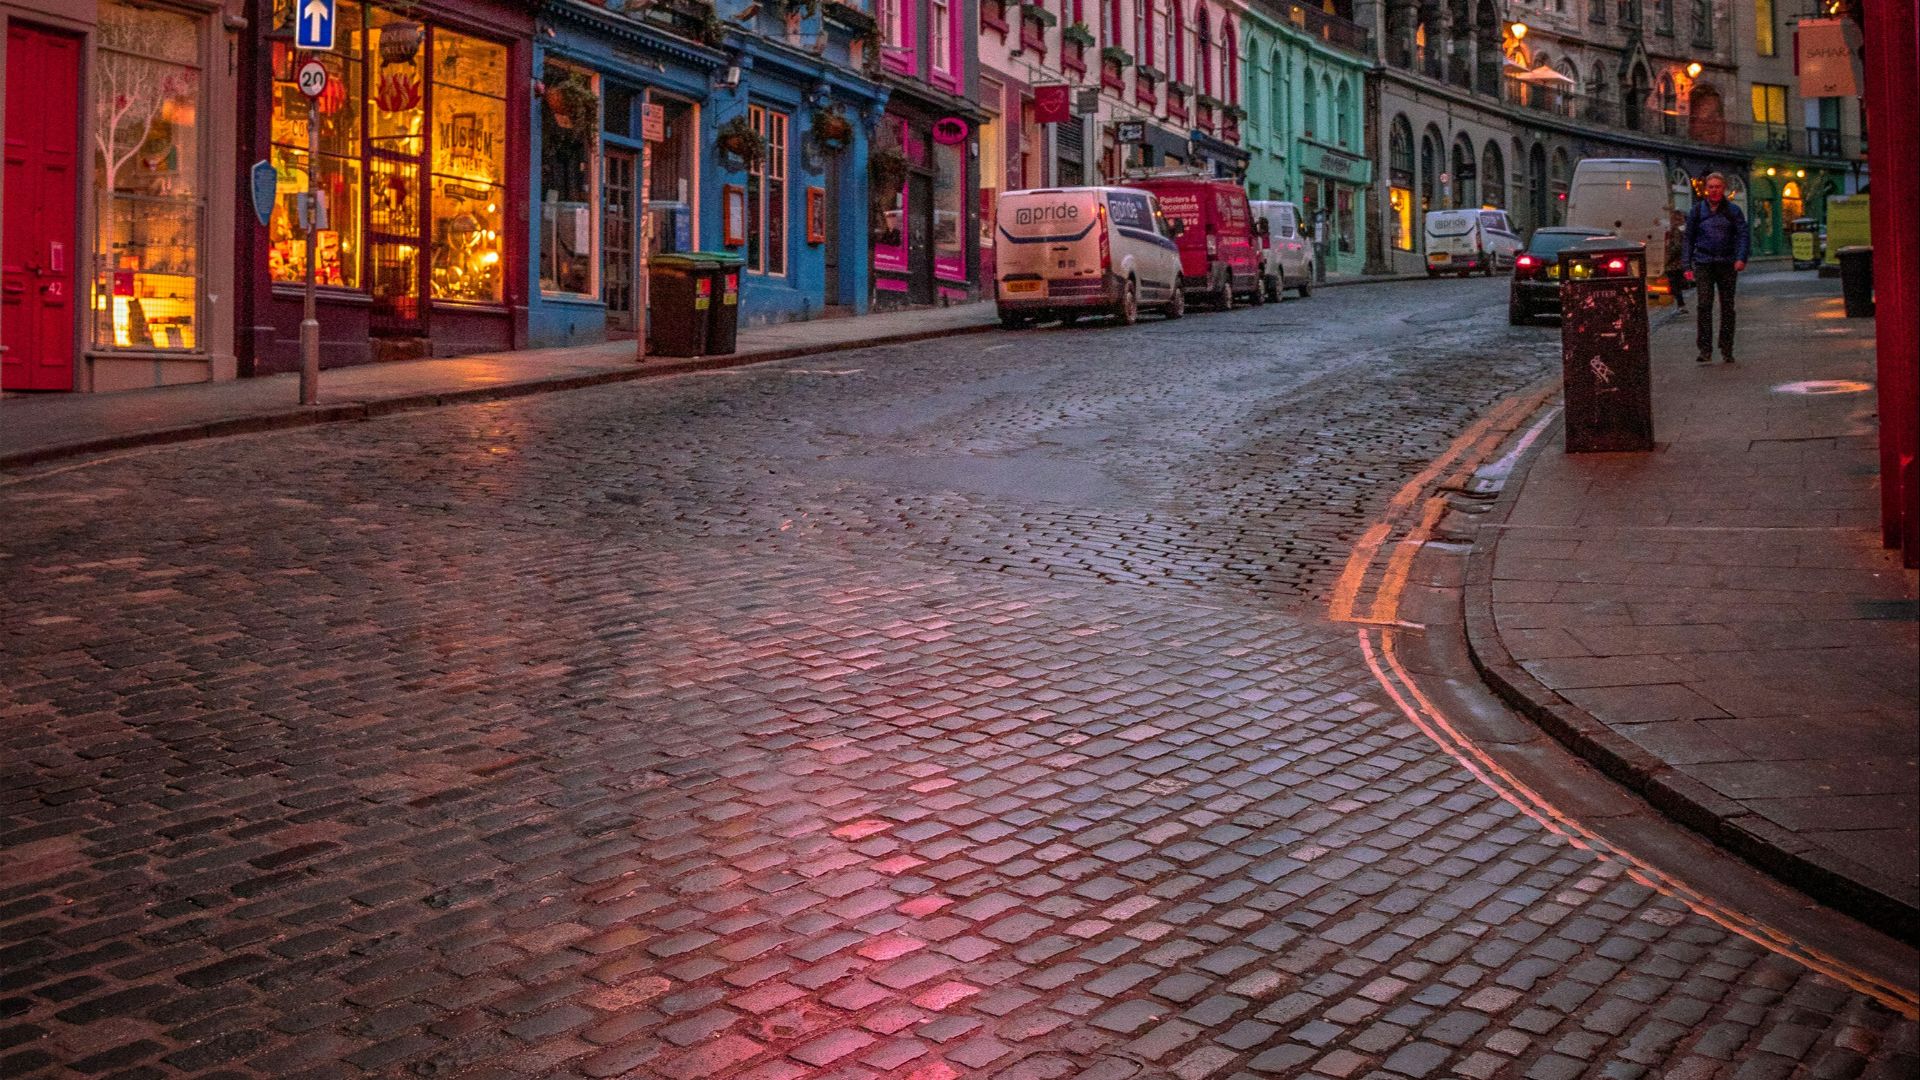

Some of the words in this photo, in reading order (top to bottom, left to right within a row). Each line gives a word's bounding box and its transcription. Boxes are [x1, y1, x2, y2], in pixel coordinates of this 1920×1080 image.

[301, 71, 324, 88] 20
[440, 121, 493, 160] MUSEUM
[1160, 196, 1189, 204] Painters
[1160, 204, 1199, 212] Decorators
[1033, 202, 1079, 225] pride
[49, 281, 62, 296] 42
